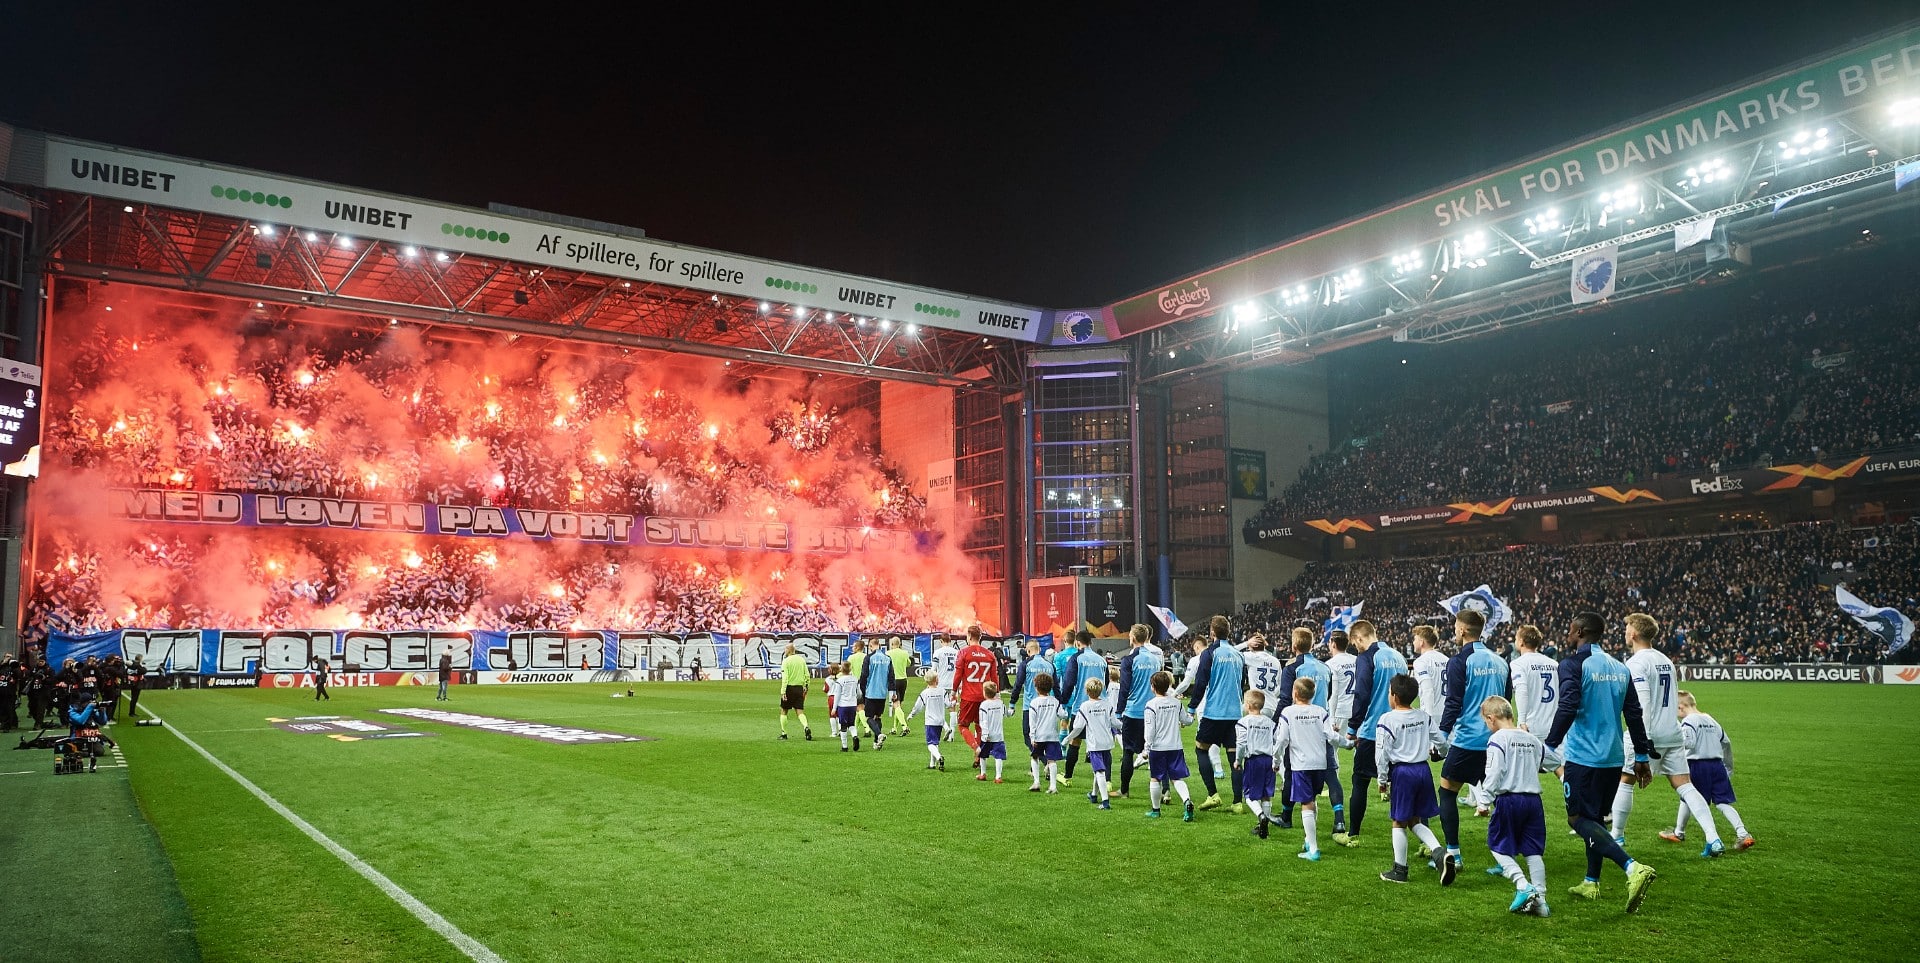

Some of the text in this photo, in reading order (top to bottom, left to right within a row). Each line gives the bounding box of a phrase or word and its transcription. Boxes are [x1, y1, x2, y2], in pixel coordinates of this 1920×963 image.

[1434, 184, 1511, 227] SKÅL
[1520, 158, 1584, 202] FOR
[1596, 80, 1821, 175] DANMARKS
[71, 158, 176, 193] UNIBET
[324, 200, 412, 231] UNIBET
[537, 234, 744, 285] Af spillere, for spillere
[837, 287, 897, 310] UNIBET
[1158, 282, 1211, 315] Carlsberg
[977, 311, 1030, 332] UNIBET
[1866, 463, 1896, 473] UEFA
[1691, 475, 1744, 494] FedEx
[108, 489, 241, 522] MED
[257, 495, 425, 532] LØVEN
[518, 509, 634, 542] VORT
[1512, 494, 1595, 511] UEFA EUROPA LEAGUE
[1267, 527, 1292, 538] AMSTEL
[219, 631, 473, 671] FØLGER
[490, 632, 603, 669] JER
[618, 633, 718, 669] FRA
[730, 632, 849, 668] KYST
[967, 661, 991, 683] 27
[1255, 667, 1279, 692] 33
[1693, 669, 1861, 681] UEFA EUROPA LEAGUE
[1540, 673, 1555, 703] 3
[1659, 674, 1671, 707] 7
